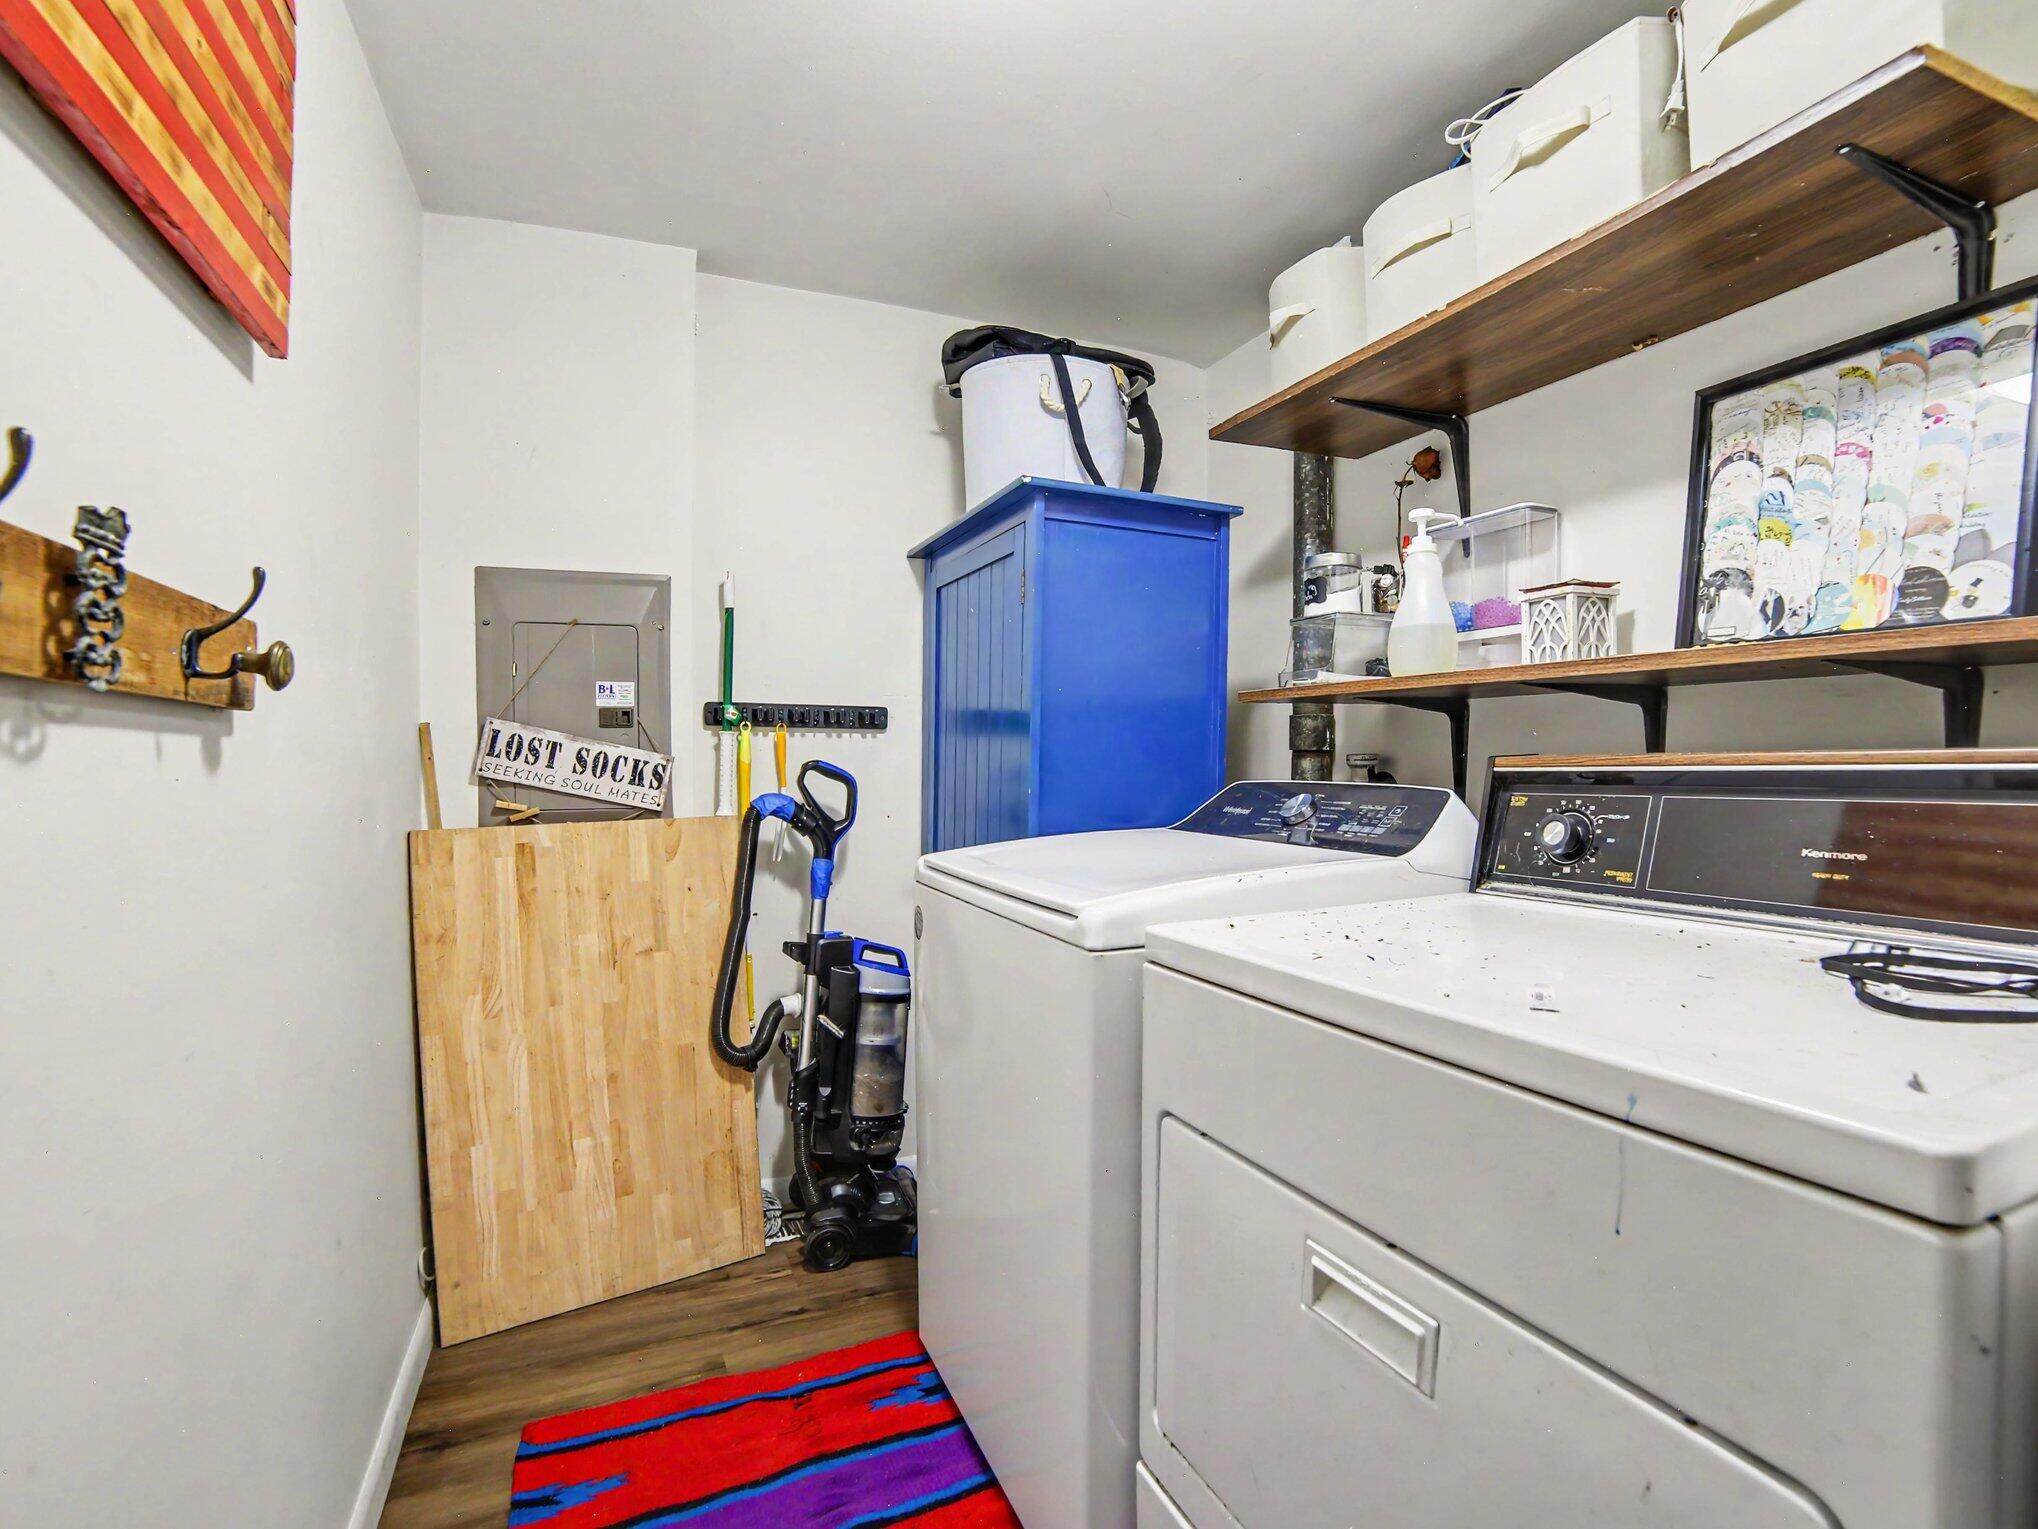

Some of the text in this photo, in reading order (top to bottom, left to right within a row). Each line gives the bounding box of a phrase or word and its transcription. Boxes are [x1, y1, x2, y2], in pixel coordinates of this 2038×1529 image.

[485, 728, 667, 791] LOST SOCKS
[482, 762, 657, 806] SEEKING SOUL MATES
[1800, 848, 1868, 861] Kenmore
